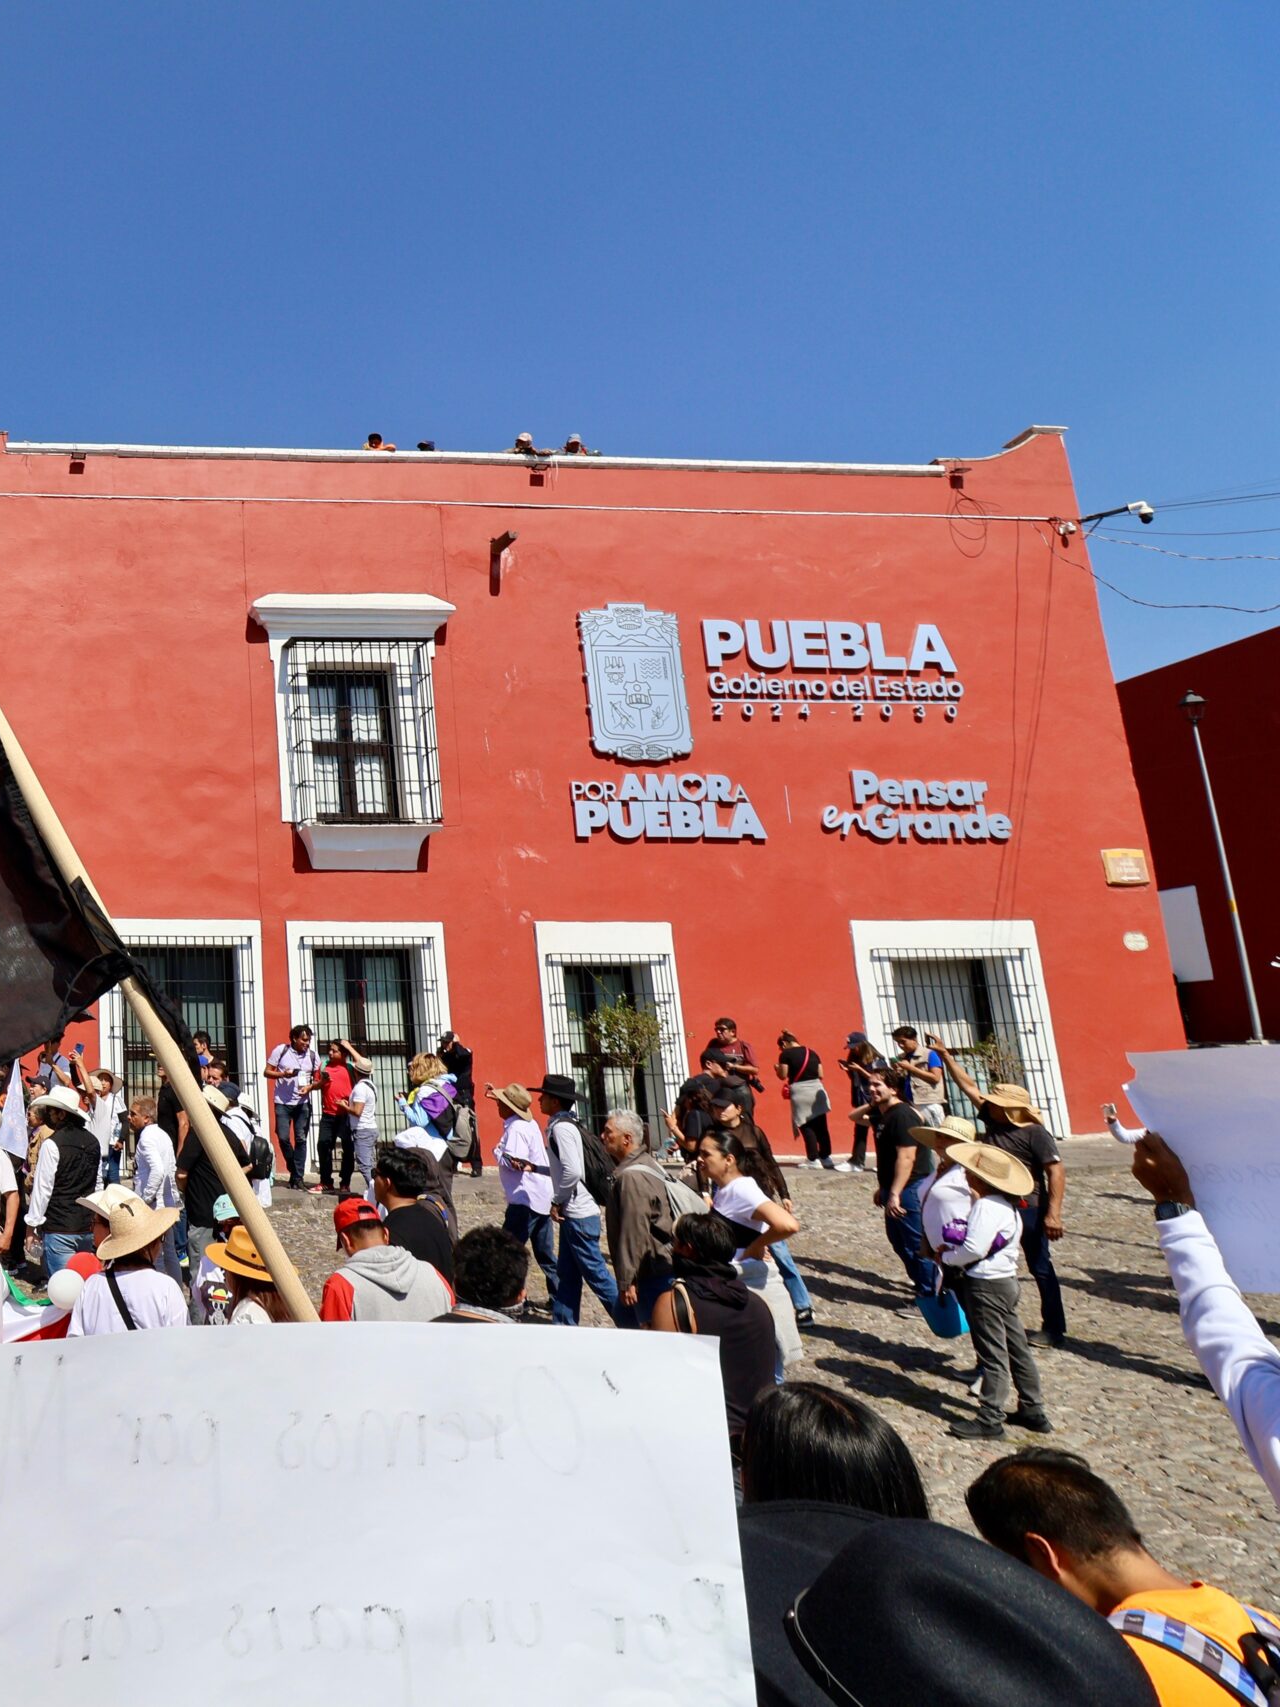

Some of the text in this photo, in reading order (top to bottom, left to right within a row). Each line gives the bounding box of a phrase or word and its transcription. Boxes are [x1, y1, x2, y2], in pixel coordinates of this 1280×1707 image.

[701, 619, 958, 673] PUEBLA
[709, 672, 964, 698] Gobierno del Estado
[571, 773, 751, 802] POR AMOR A
[851, 770, 988, 806] Pensar
[574, 800, 768, 839] PUEBLA
[822, 804, 1013, 839] en Grande
